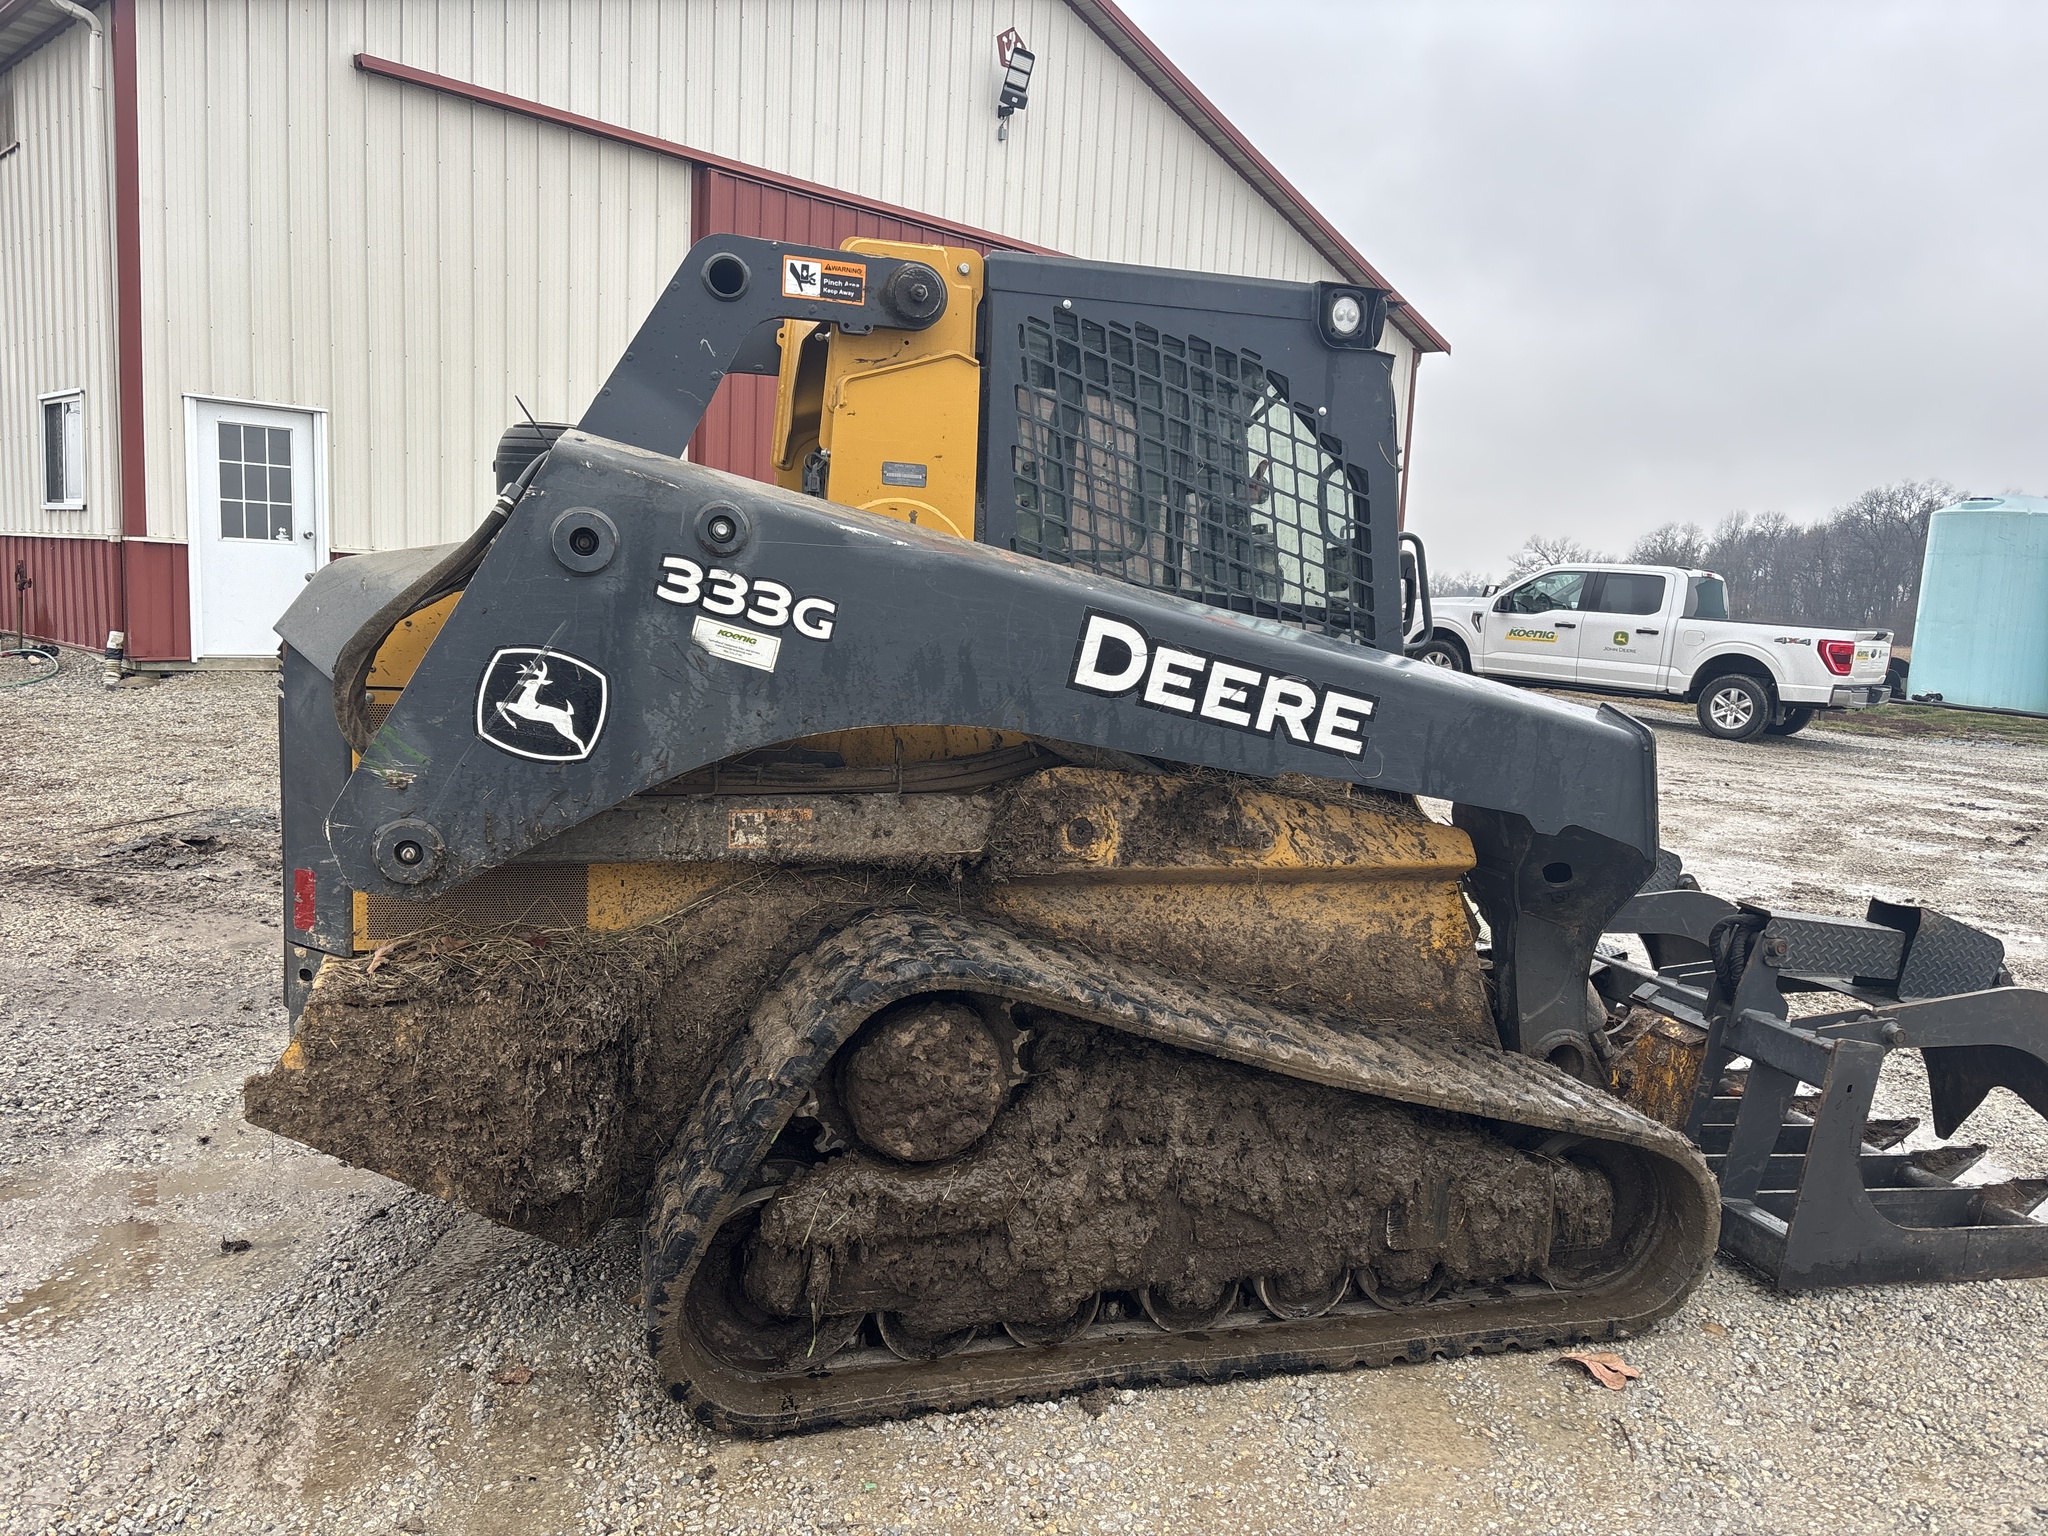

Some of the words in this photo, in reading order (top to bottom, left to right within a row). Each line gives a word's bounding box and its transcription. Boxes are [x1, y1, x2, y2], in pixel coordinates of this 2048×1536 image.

[831, 265, 862, 274] WARNING
[823, 278, 843, 287] Pinch
[823, 287, 838, 295] Keep
[839, 289, 854, 297] Away
[656, 556, 837, 640] 333G
[1074, 615, 1374, 755] DEERE
